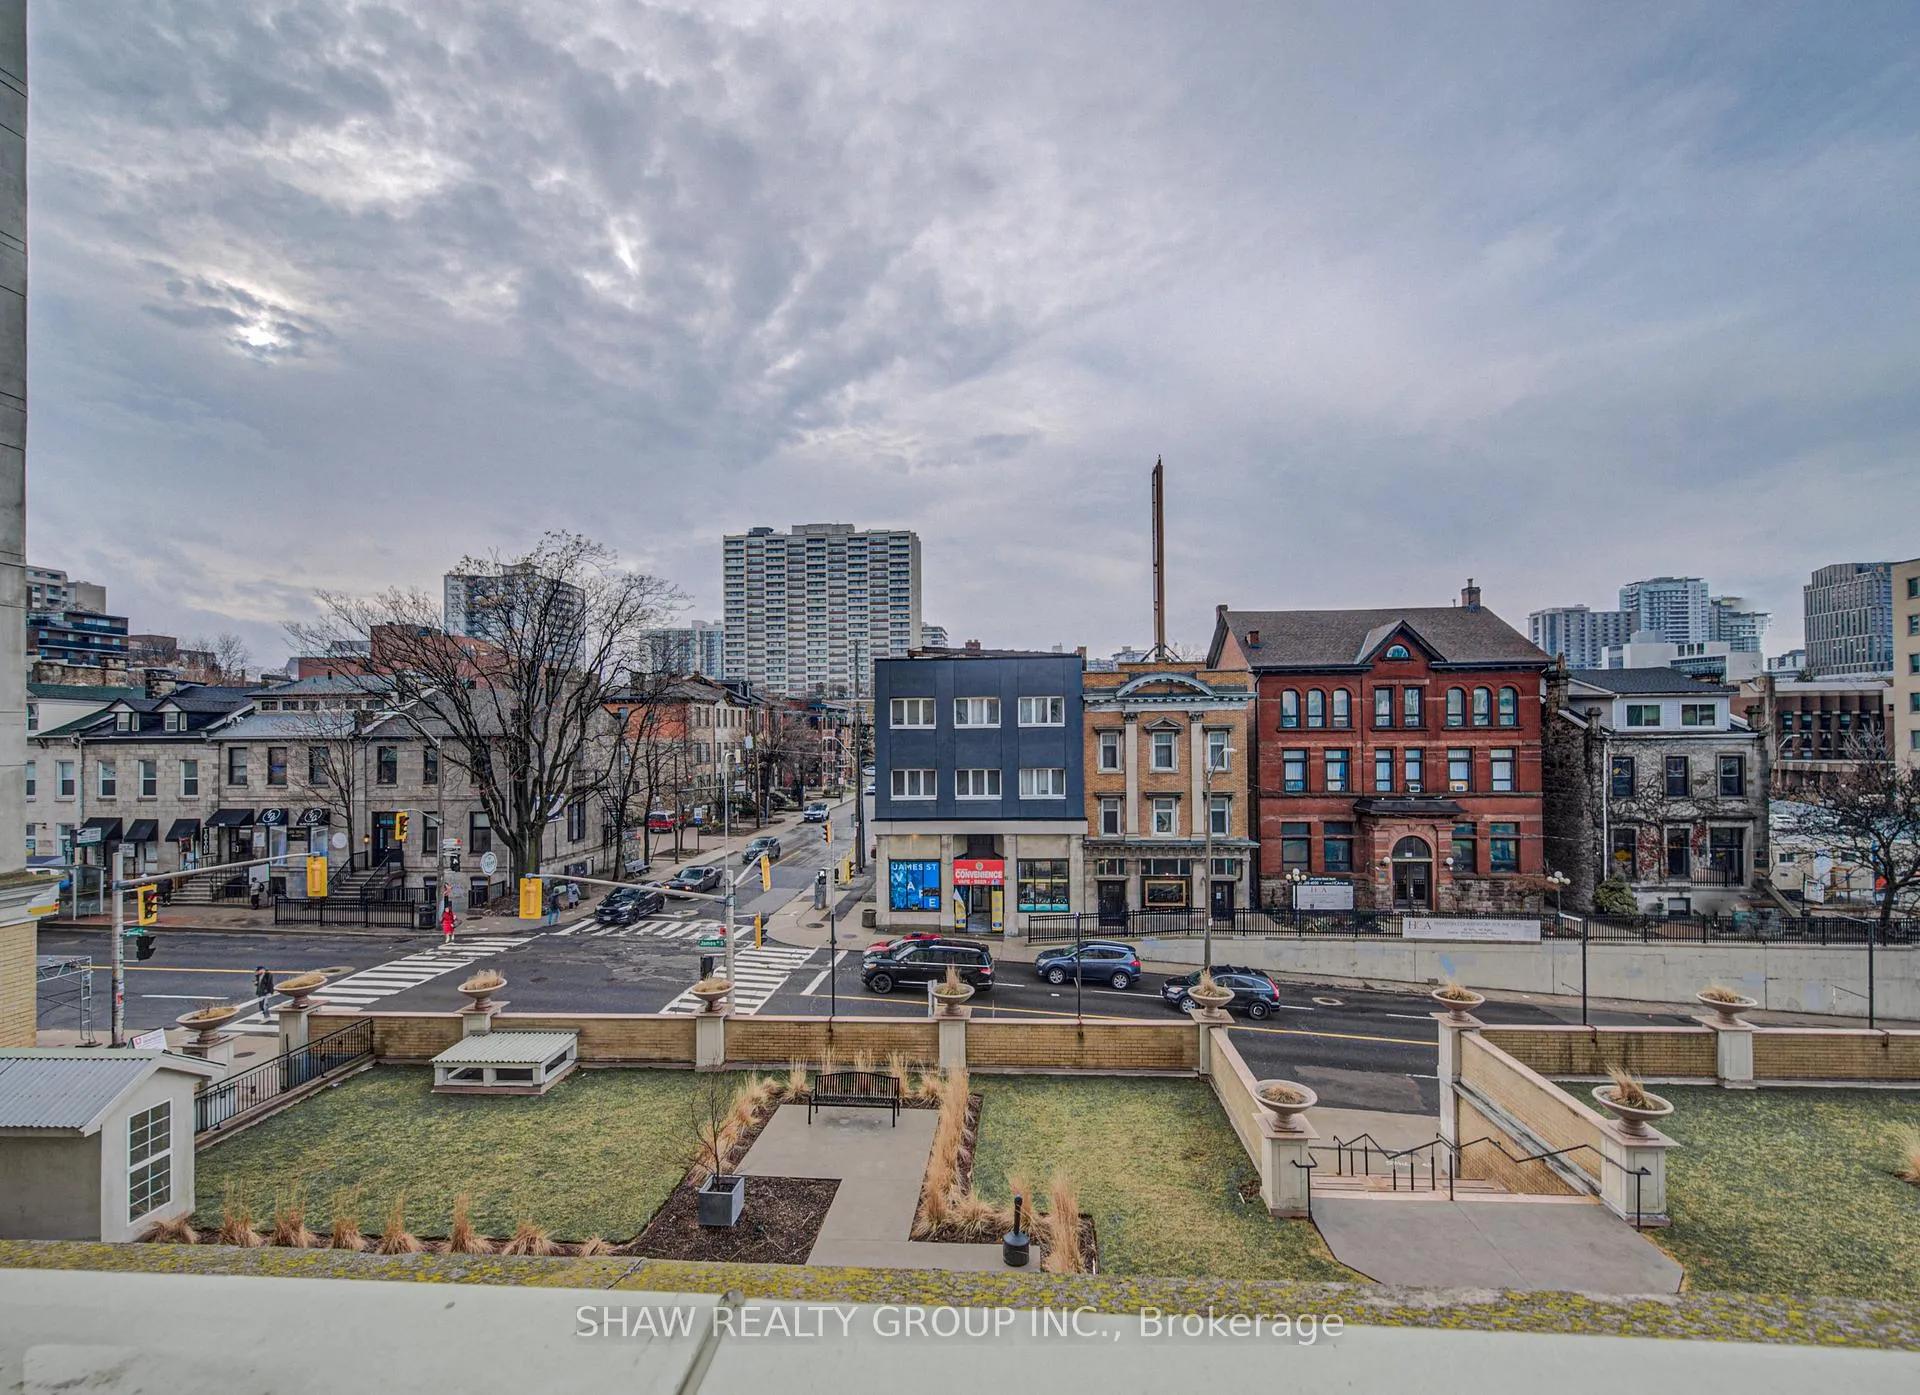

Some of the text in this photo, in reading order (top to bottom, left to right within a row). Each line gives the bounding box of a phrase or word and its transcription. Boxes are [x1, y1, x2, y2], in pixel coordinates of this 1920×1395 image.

[893, 863, 937, 871] JAMES ST
[955, 870, 1003, 879] CONVENIENCE
